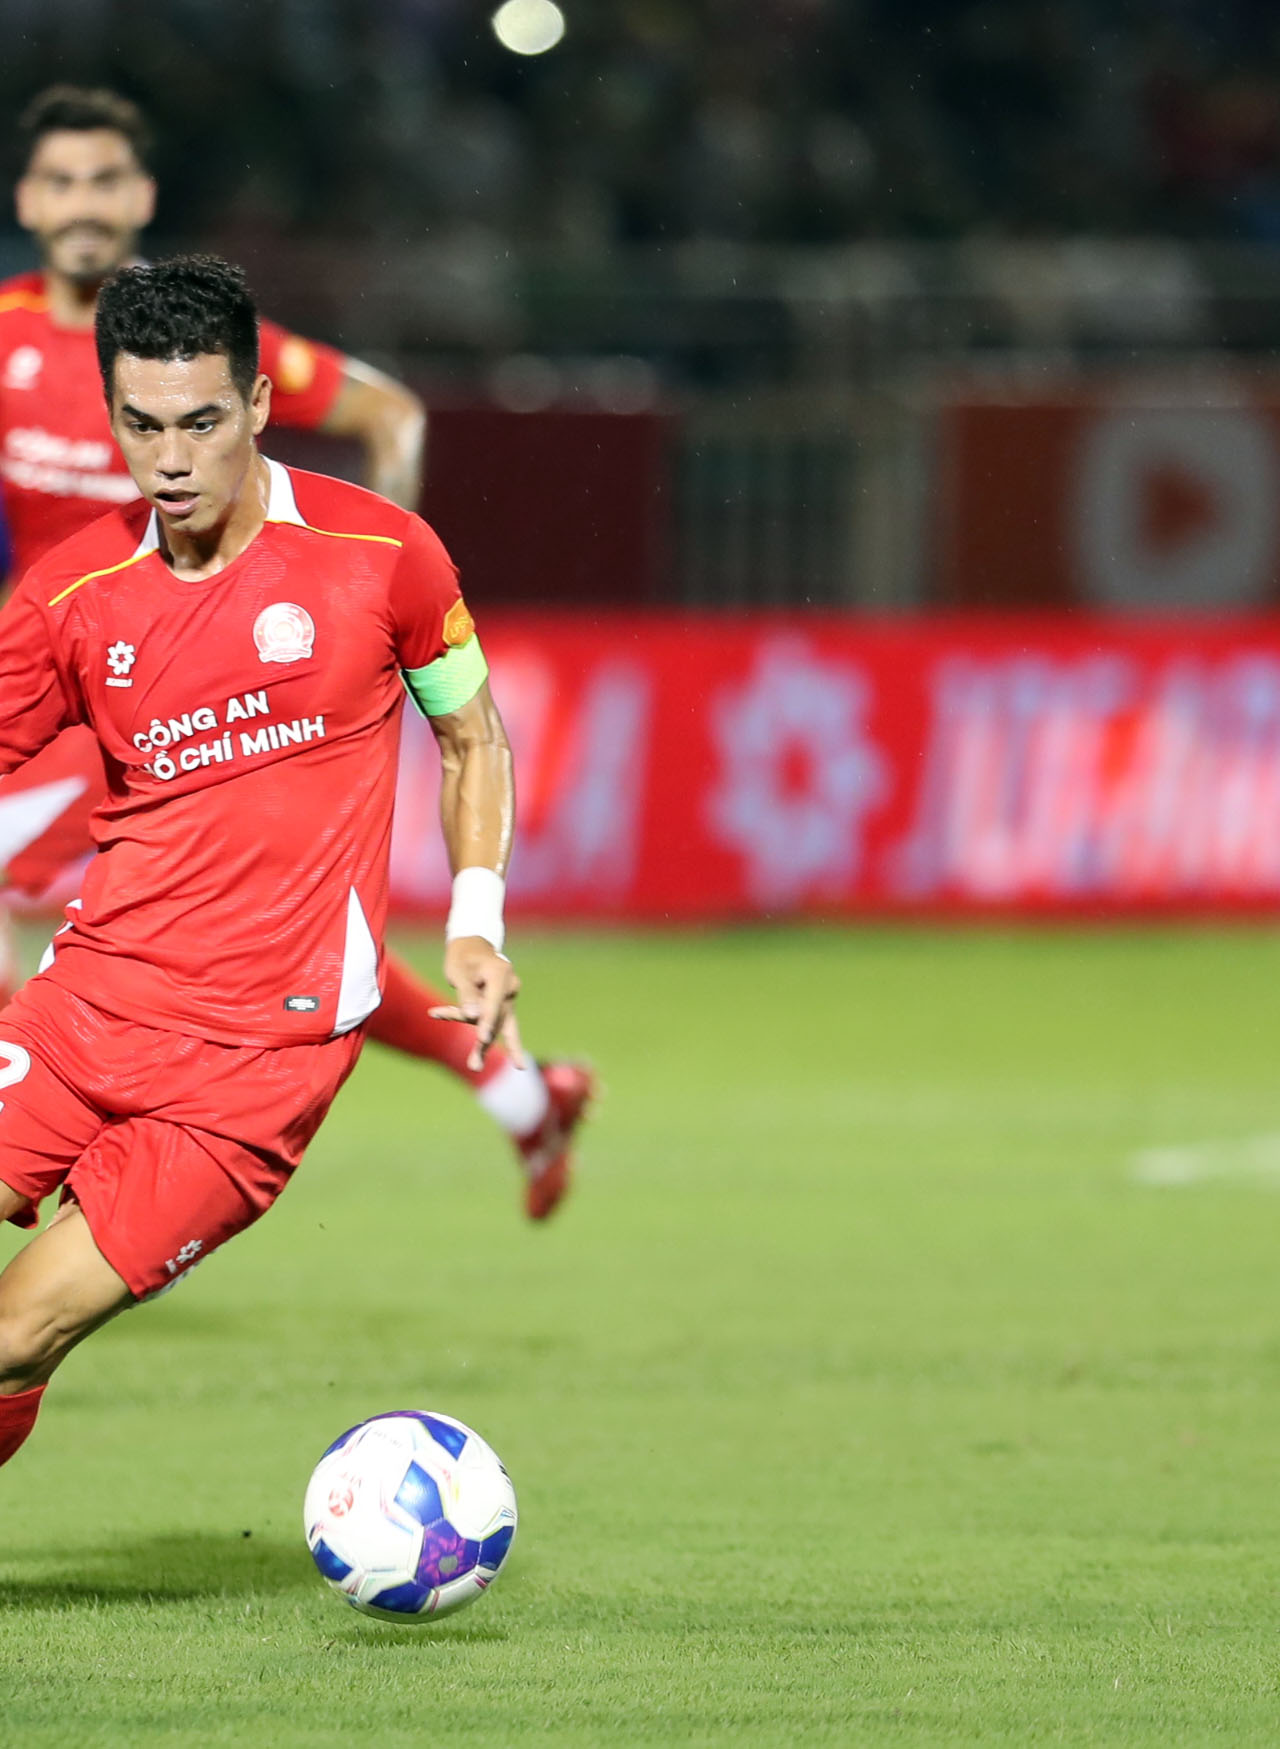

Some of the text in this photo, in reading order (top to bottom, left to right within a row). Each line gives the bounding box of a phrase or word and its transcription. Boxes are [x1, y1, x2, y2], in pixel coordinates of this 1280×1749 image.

[133, 690, 270, 753] CÔNG AN
[179, 731, 234, 771] CHÍ
[239, 715, 326, 756] MINH
